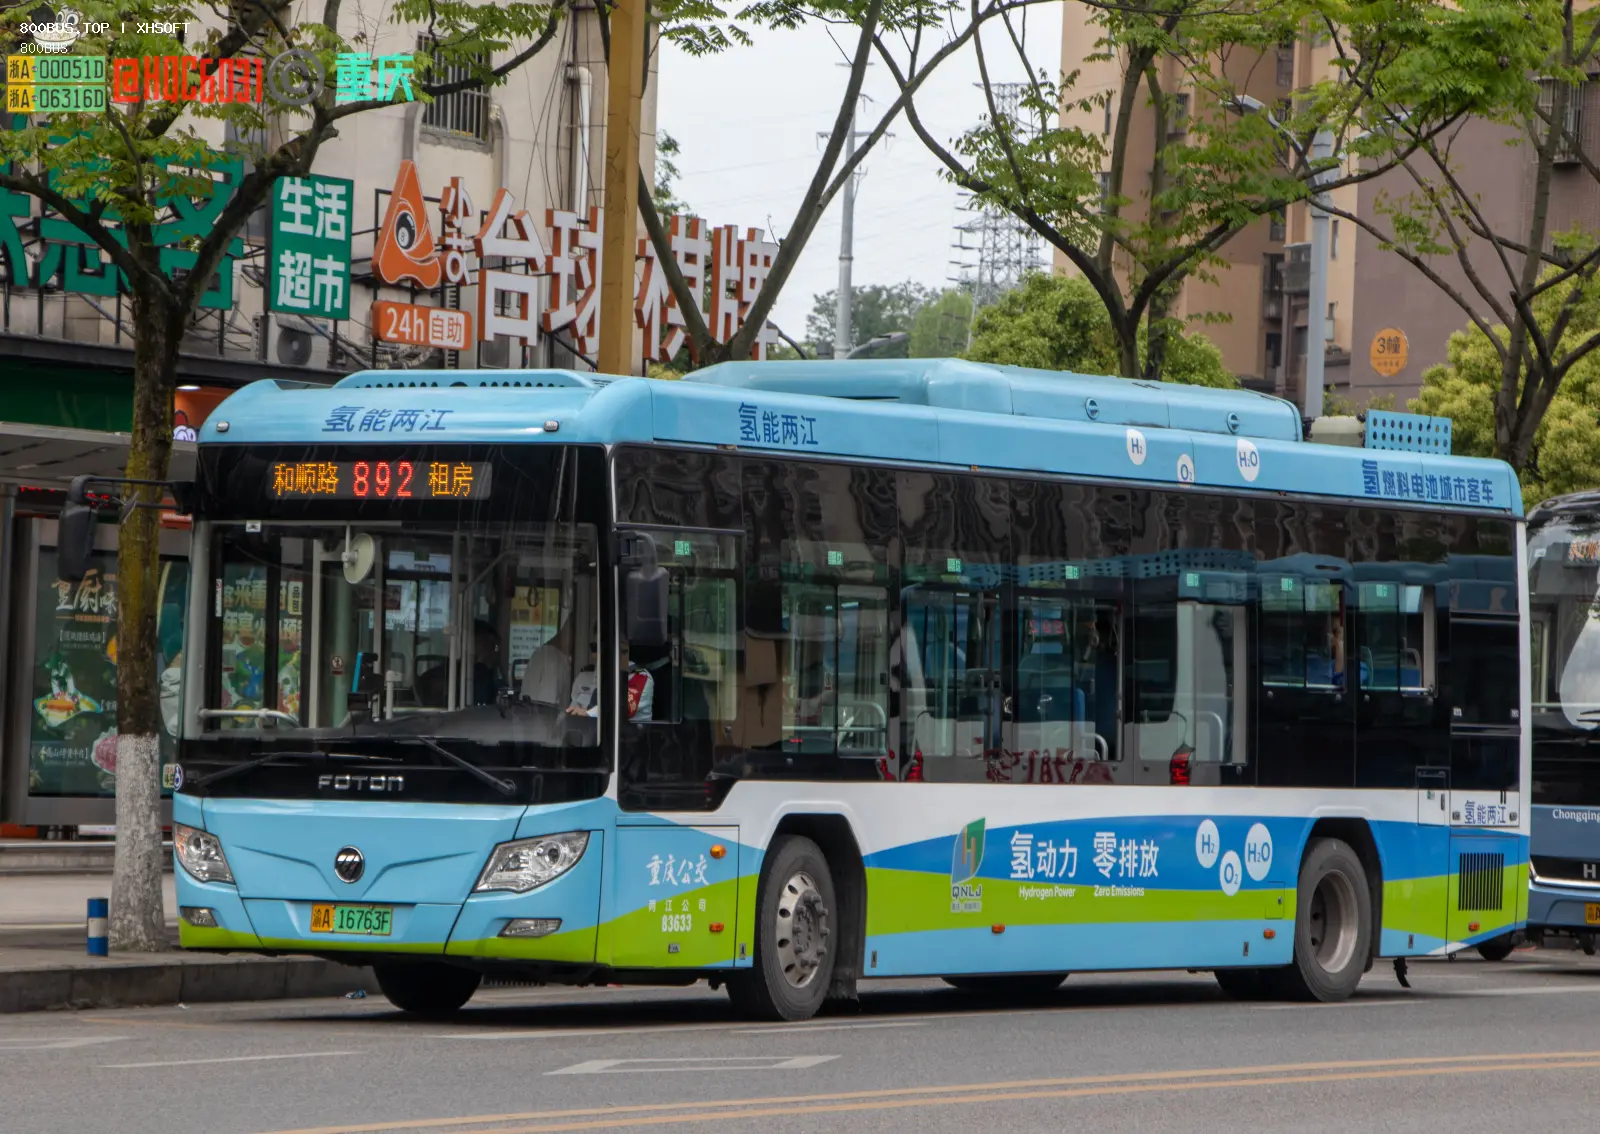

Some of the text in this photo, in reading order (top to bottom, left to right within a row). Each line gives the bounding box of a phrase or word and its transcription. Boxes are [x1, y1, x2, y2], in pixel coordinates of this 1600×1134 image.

[280, 177, 347, 241] 生活
[277, 249, 346, 312] 超市
[386, 307, 462, 343] 24h 自助
[321, 405, 454, 432] 氢能两江
[738, 401, 819, 445] 氢能两江
[272, 462, 474, 496] 和顺路 892 租房
[1361, 459, 1494, 503] 氢燃料电池城市客车
[318, 775, 405, 791] FOTON
[1464, 800, 1507, 825] 氢能两江
[646, 854, 710, 886] 重庆公交
[1010, 830, 1160, 879] 氢动力 零排放
[952, 884, 983, 899] QNLJ
[1019, 884, 1145, 900] Hydrogen Power Zero Emissions
[661, 914, 692, 932] 83633
